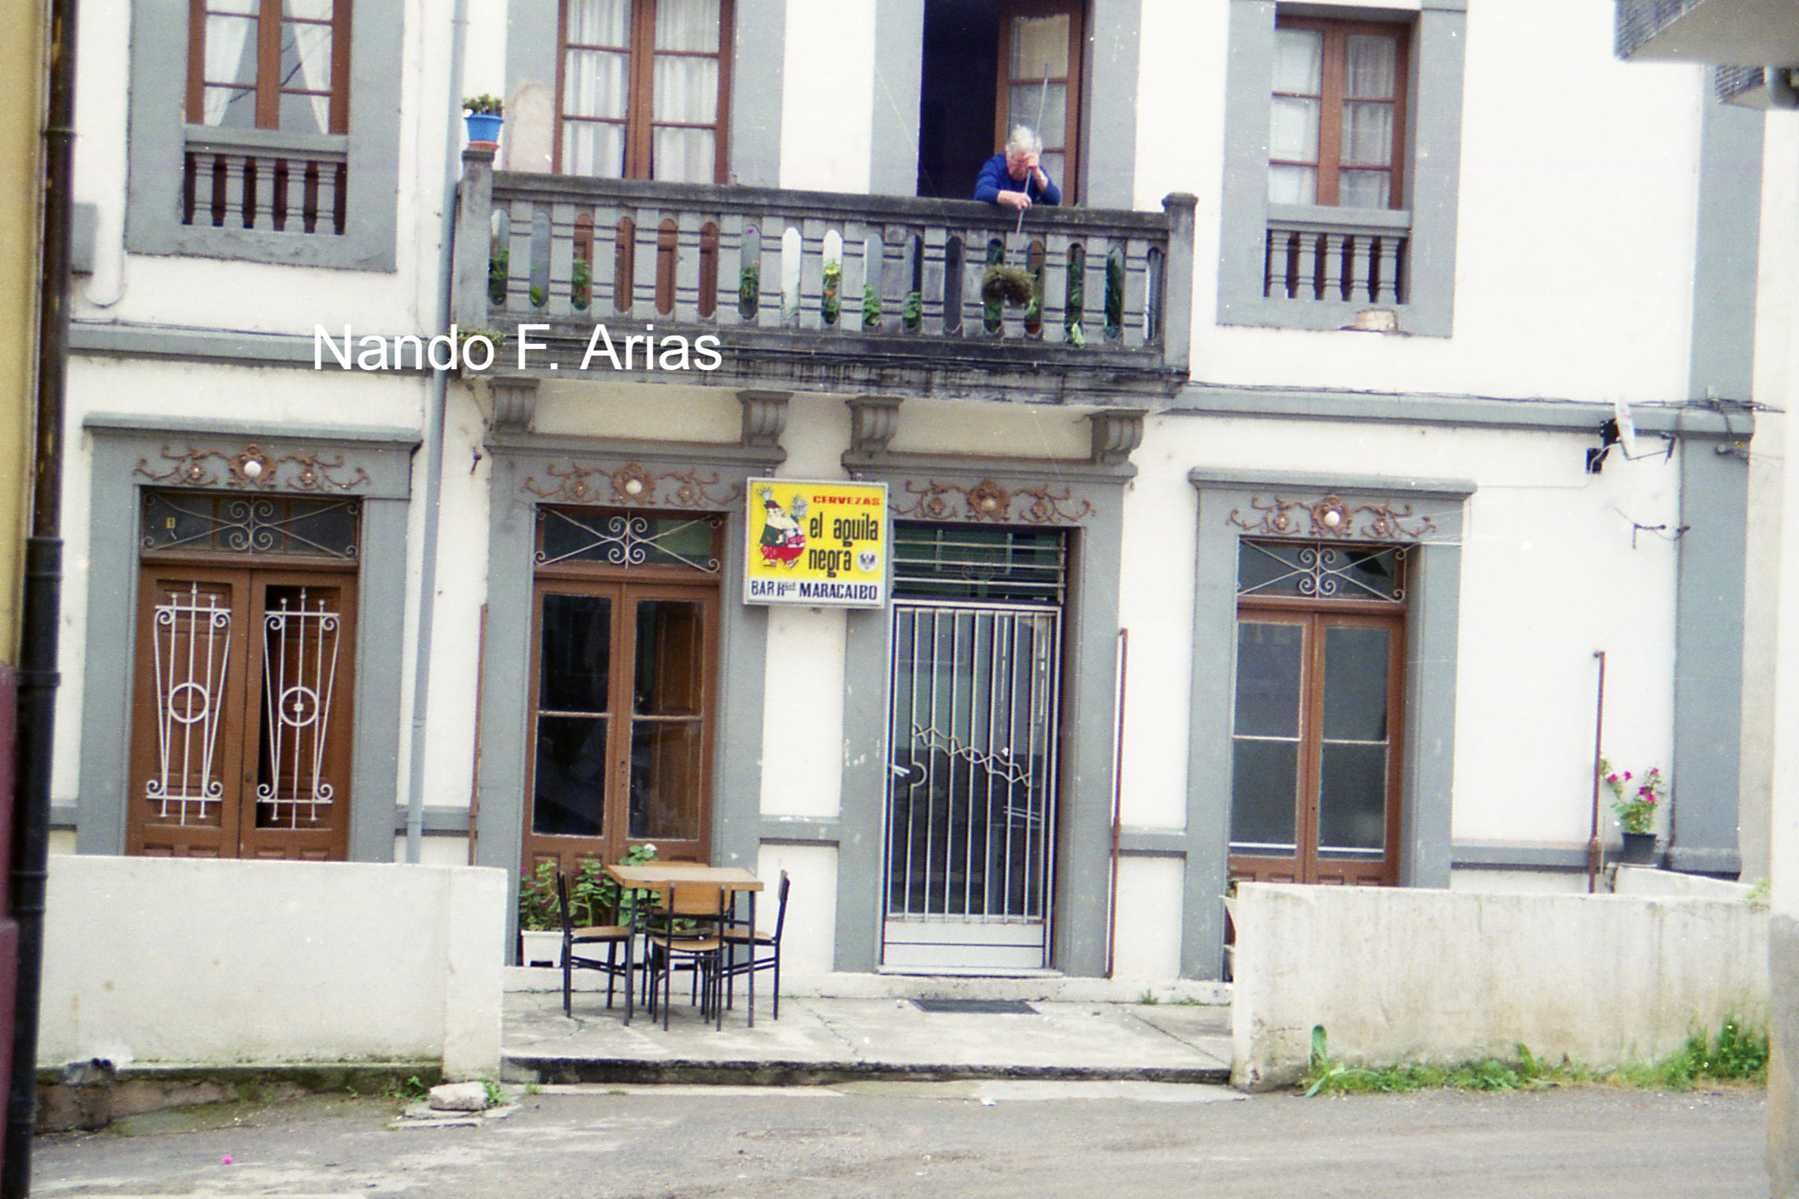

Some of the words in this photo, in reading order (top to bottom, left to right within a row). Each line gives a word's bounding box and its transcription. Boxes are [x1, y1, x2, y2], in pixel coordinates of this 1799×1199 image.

[812, 495, 881, 506] CERVEZAS
[809, 512, 823, 538] el
[833, 512, 879, 548] aguila
[808, 549, 852, 578] negra
[751, 580, 775, 597] BAR
[799, 582, 878, 601] MARACAIBO
